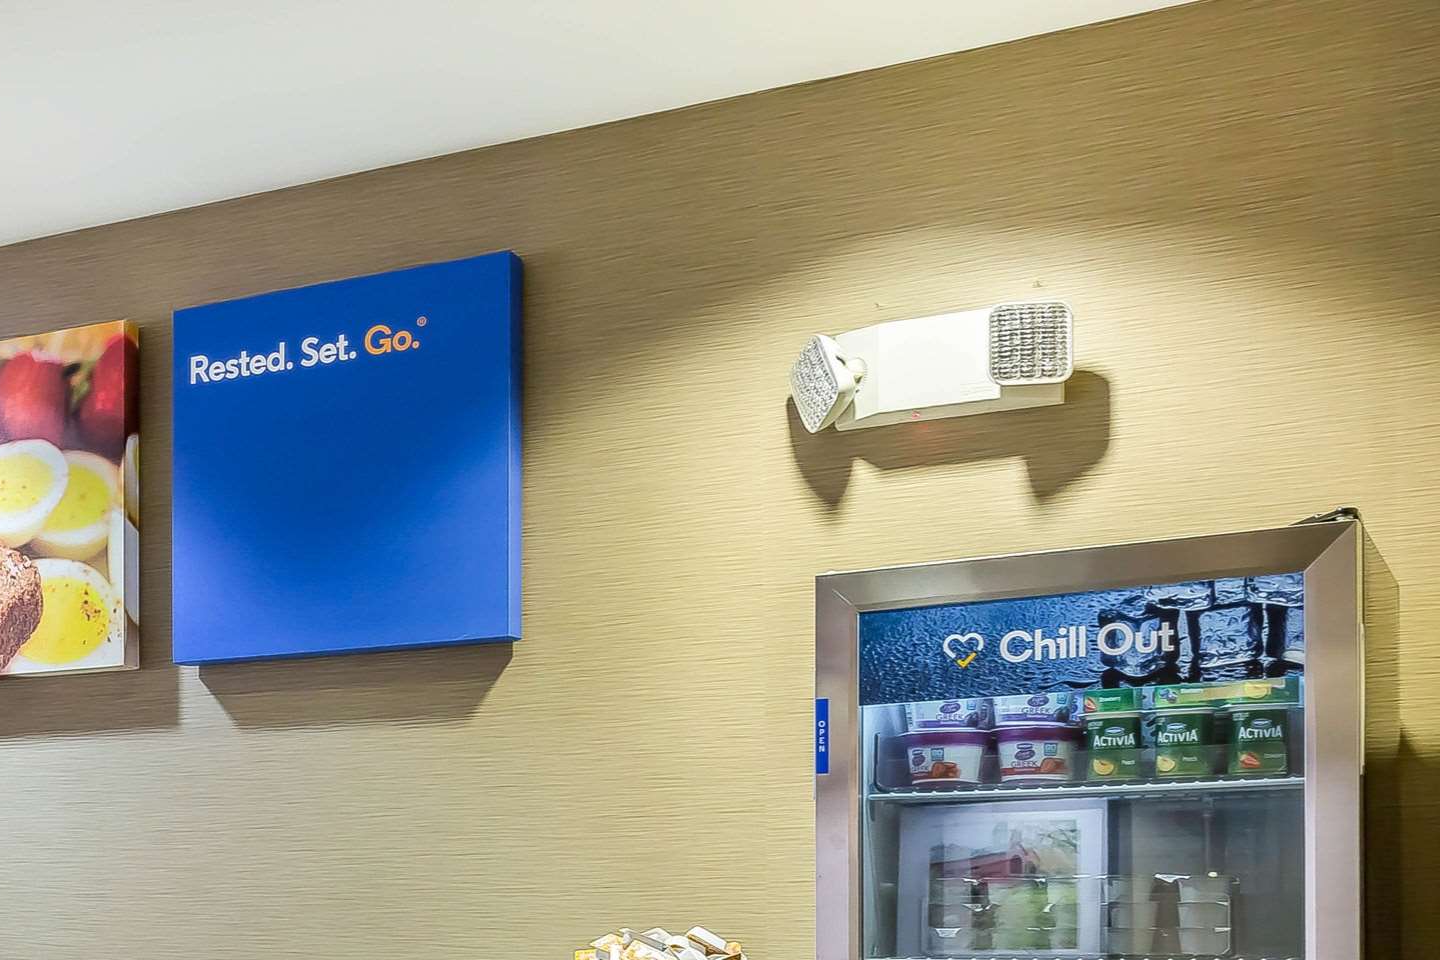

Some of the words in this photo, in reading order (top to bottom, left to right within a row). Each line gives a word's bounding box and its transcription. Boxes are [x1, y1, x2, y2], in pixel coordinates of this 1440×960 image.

[189, 341, 294, 386] Rested.
[300, 334, 357, 368] Set.
[999, 625, 1087, 663] Chill
[1096, 621, 1175, 657] Out
[817, 720, 826, 753] OPEN
[1093, 733, 1136, 748] ACTIVIA
[1157, 729, 1199, 744] ACTIVIA
[1238, 724, 1283, 739] ACTIVIA
